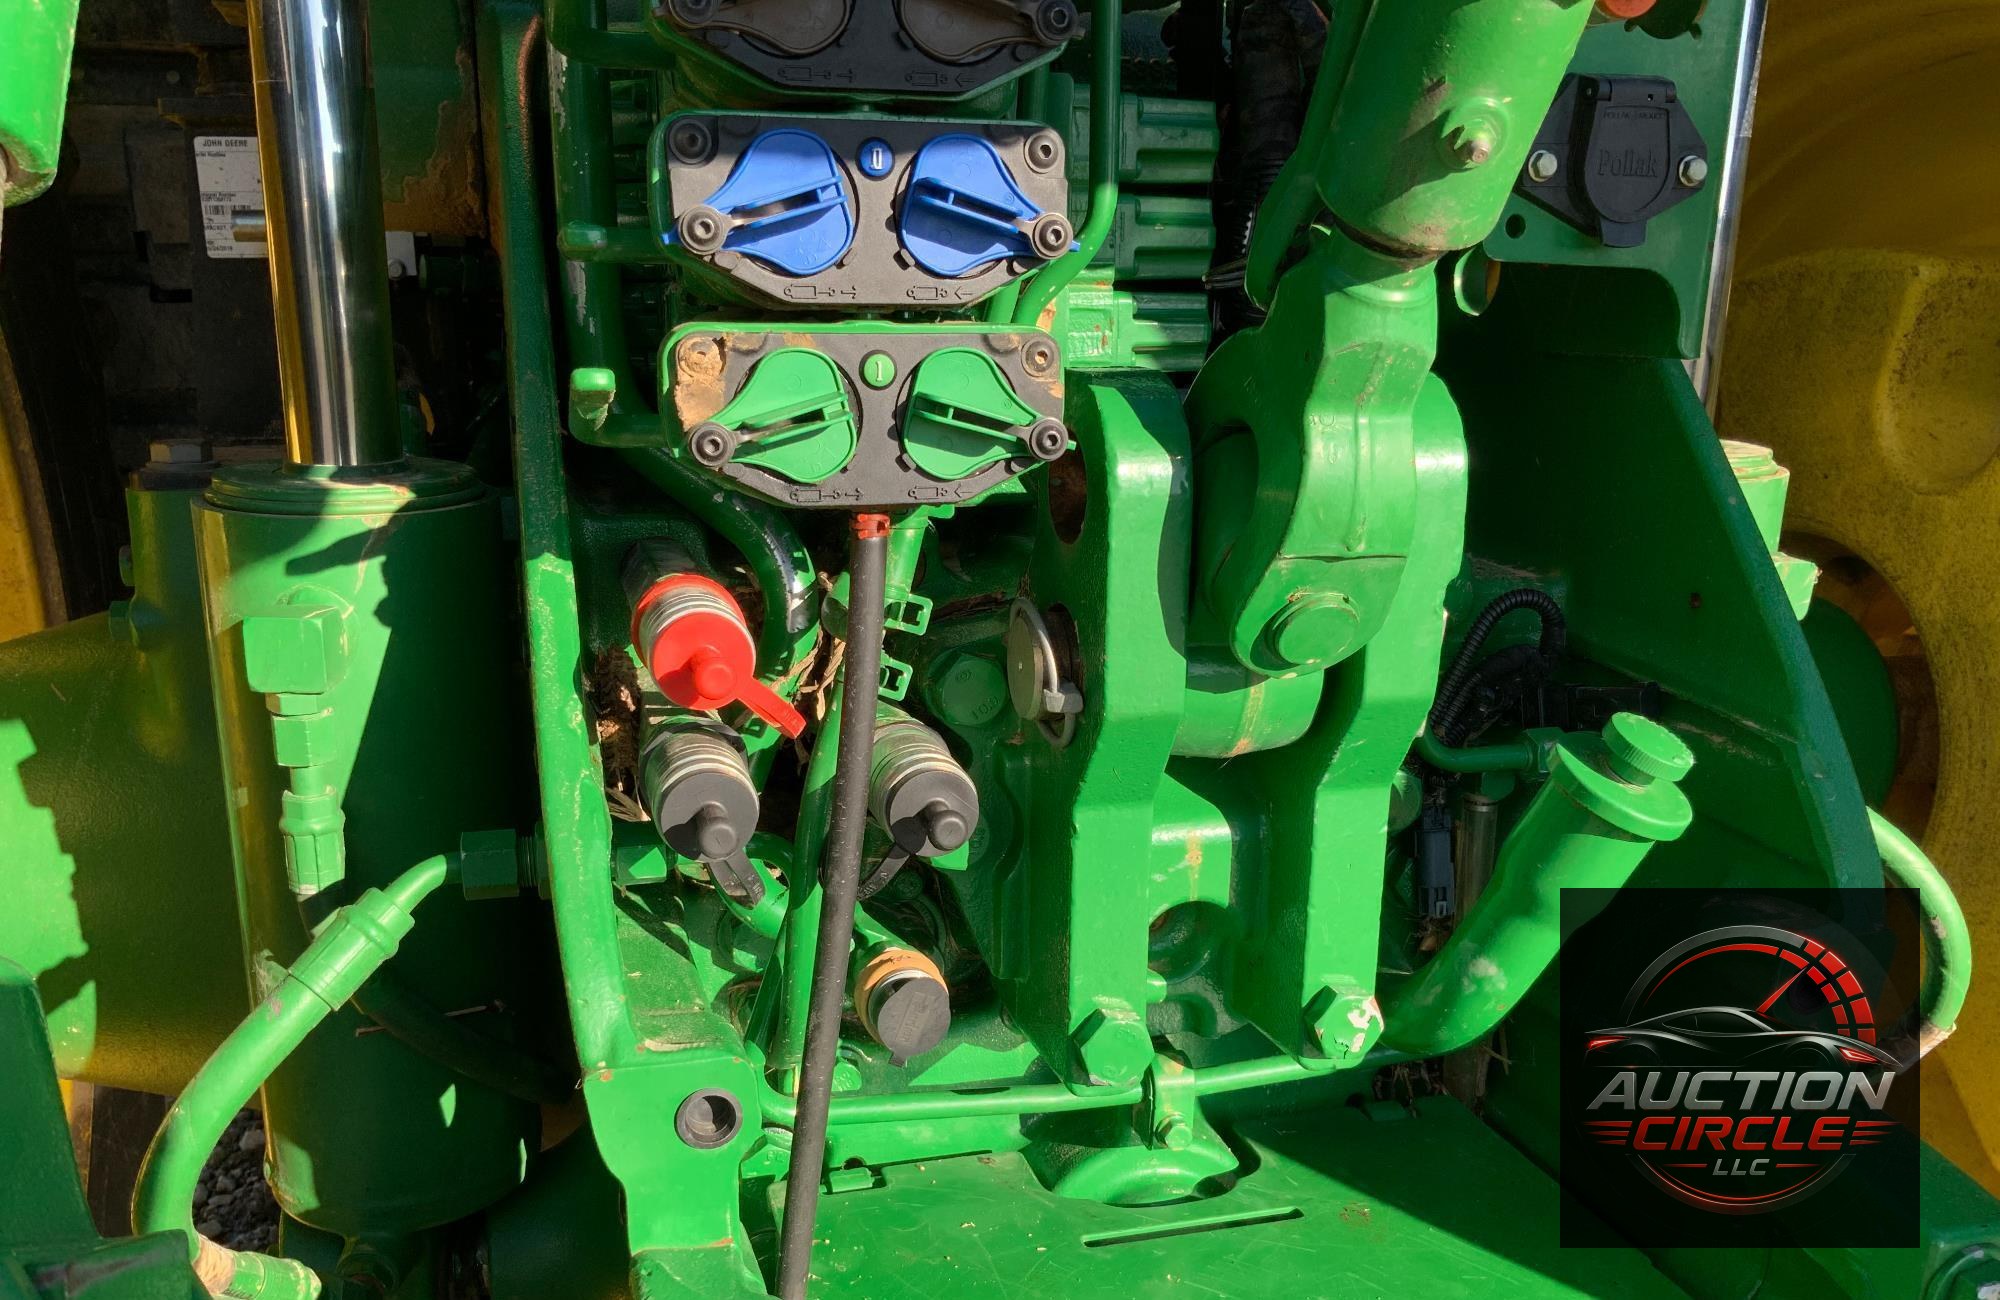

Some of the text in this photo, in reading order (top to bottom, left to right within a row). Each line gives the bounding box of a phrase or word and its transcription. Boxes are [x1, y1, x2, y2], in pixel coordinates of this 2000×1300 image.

[203, 139, 248, 148] JOHN DEERE
[1598, 147, 1658, 178] Pollak
